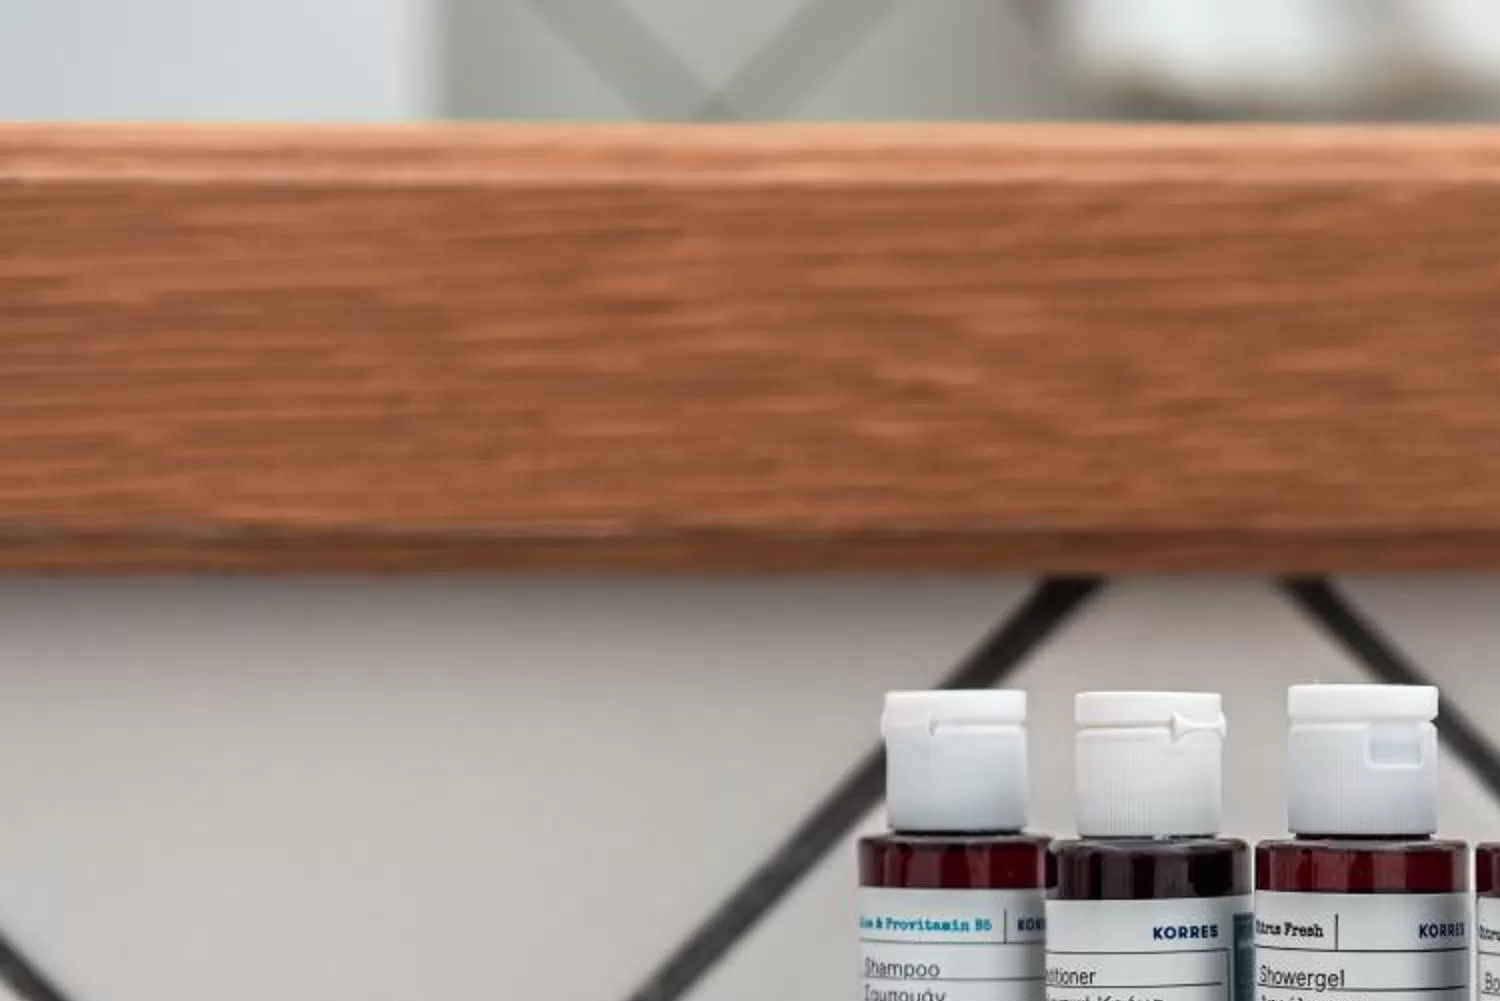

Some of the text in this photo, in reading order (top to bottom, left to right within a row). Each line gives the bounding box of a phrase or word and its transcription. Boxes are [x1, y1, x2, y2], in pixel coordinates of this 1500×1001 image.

[885, 916, 970, 933] Provitamin
[974, 919, 993, 932] B5
[1153, 924, 1219, 940] KORRES
[1284, 920, 1325, 938] Fresh
[864, 955, 941, 979] Shampoo
[1258, 964, 1345, 992] Showergel
